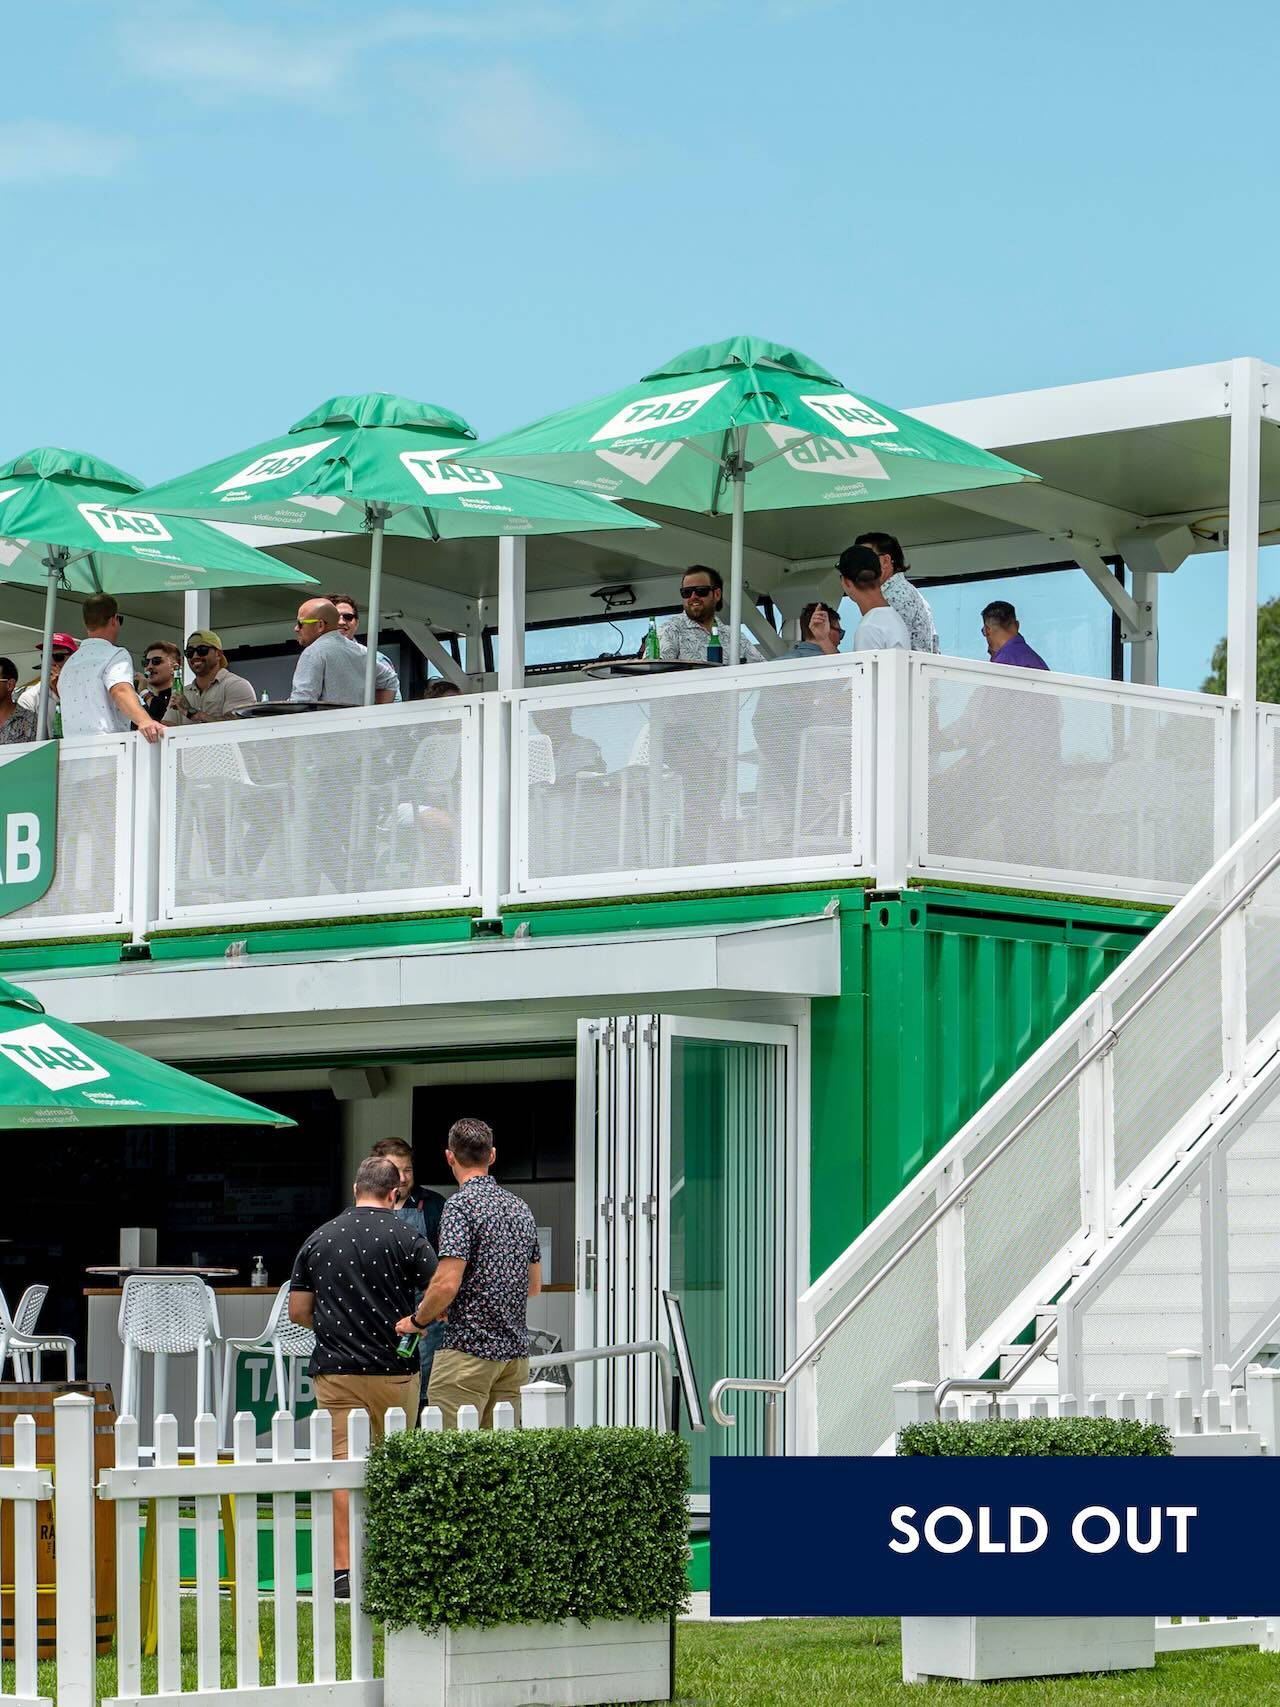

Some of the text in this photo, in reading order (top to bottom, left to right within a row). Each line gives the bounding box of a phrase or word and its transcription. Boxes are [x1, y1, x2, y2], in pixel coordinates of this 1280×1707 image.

[624, 399, 699, 423] TAB
[810, 401, 887, 426] TAB
[247, 455, 307, 477] TAB
[409, 457, 491, 484] TAB
[86, 509, 162, 536] TAB
[0, 1043, 95, 1072] TAB
